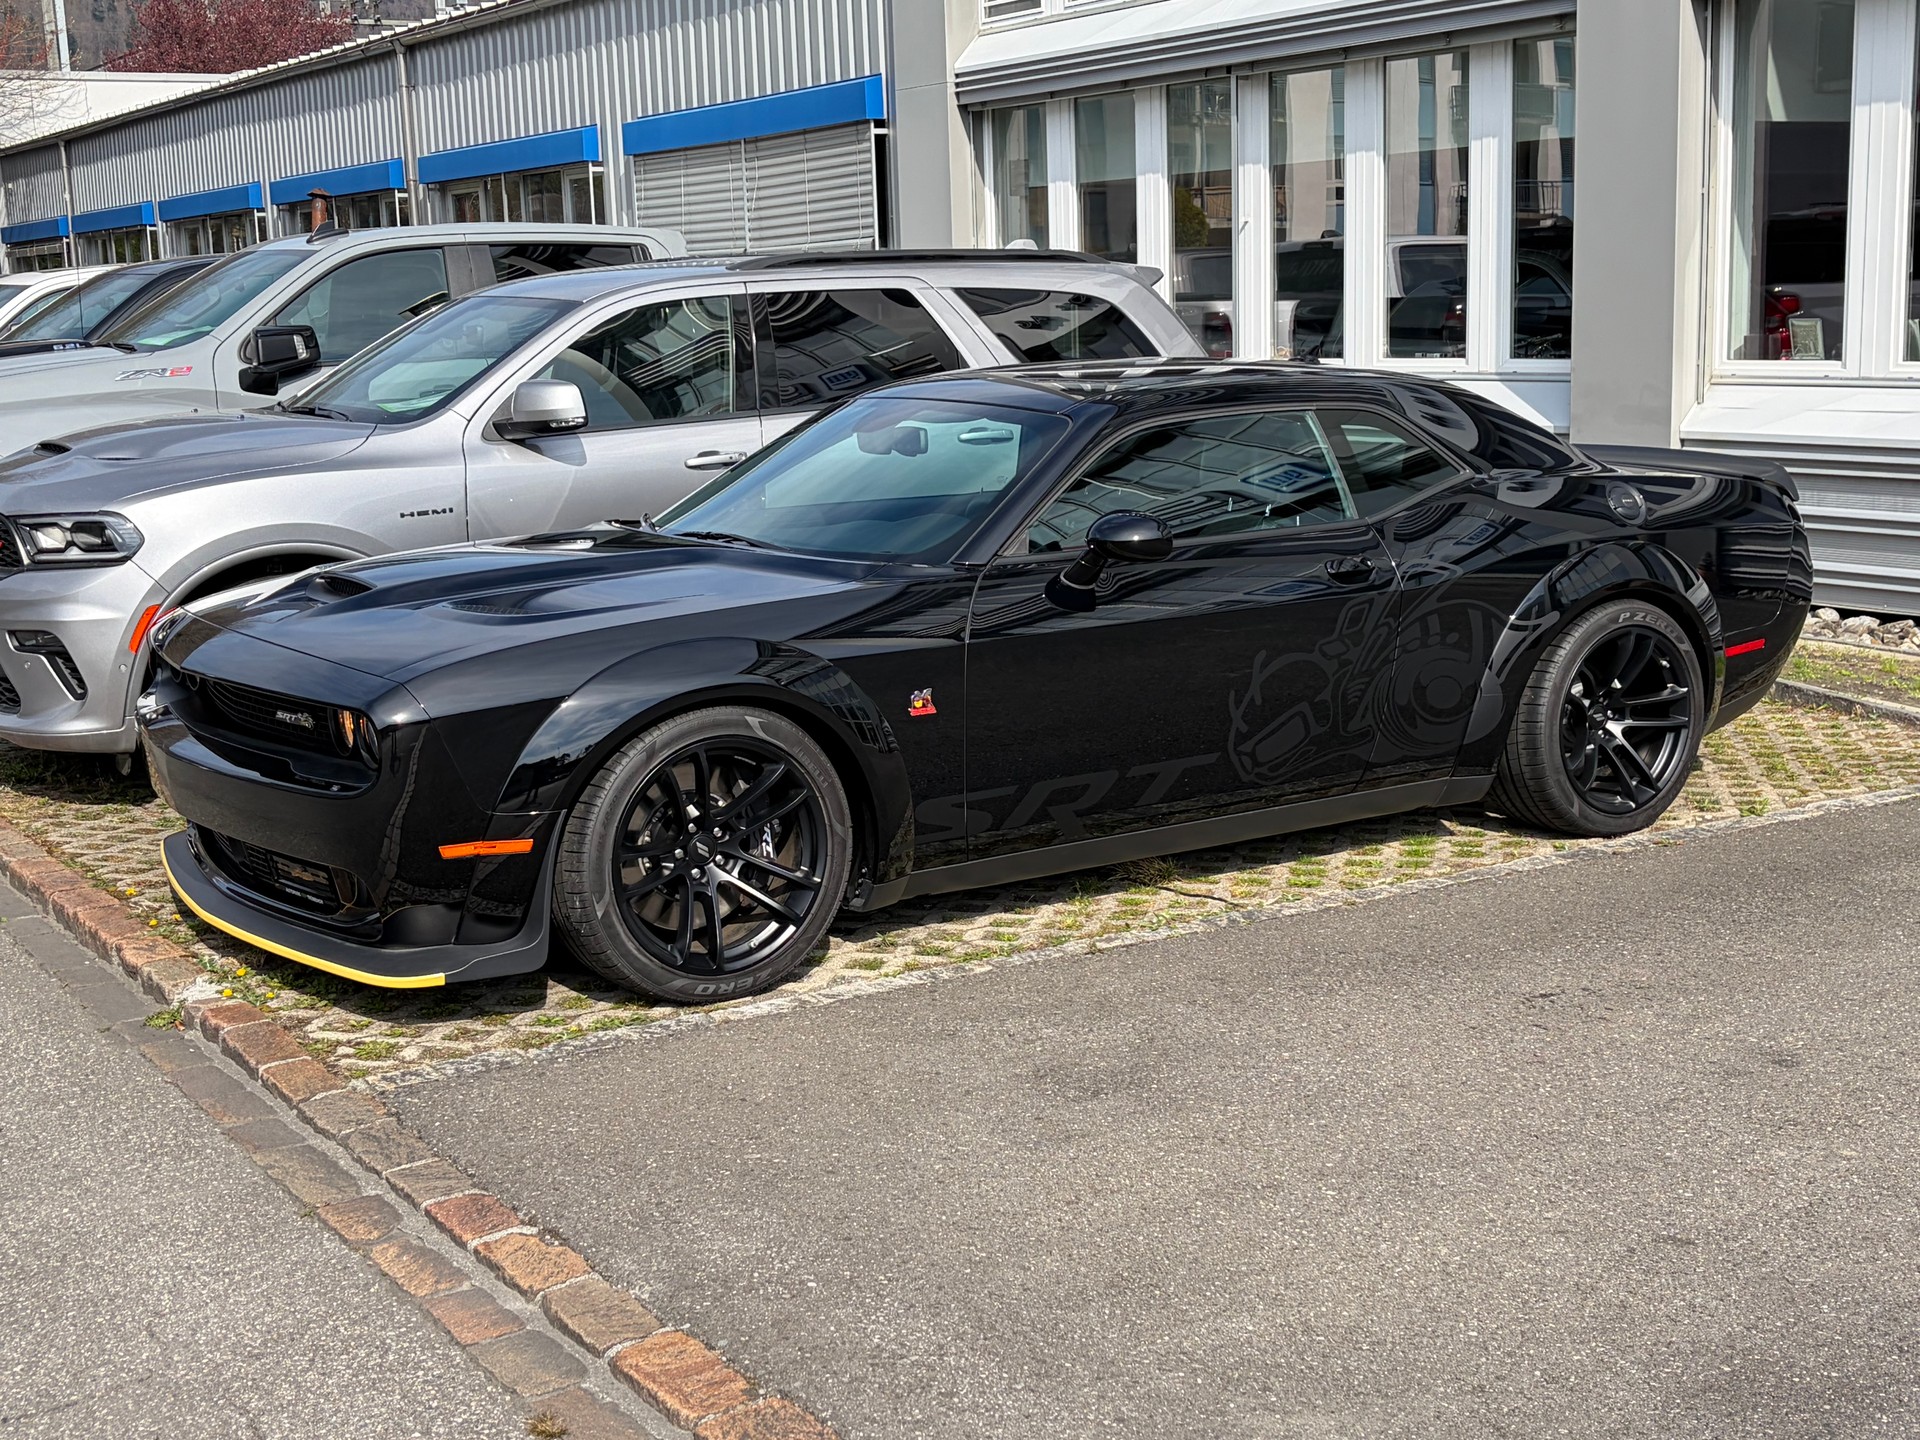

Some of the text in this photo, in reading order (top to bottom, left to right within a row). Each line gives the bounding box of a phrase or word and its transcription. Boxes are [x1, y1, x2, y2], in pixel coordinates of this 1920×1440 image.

[114, 365, 193, 381] ZR2
[400, 507, 454, 518] HEMI
[1618, 611, 1679, 639] P ZERO
[276, 711, 298, 723] SRT
[911, 751, 1222, 846] SRT
[693, 967, 773, 996] ZERO
